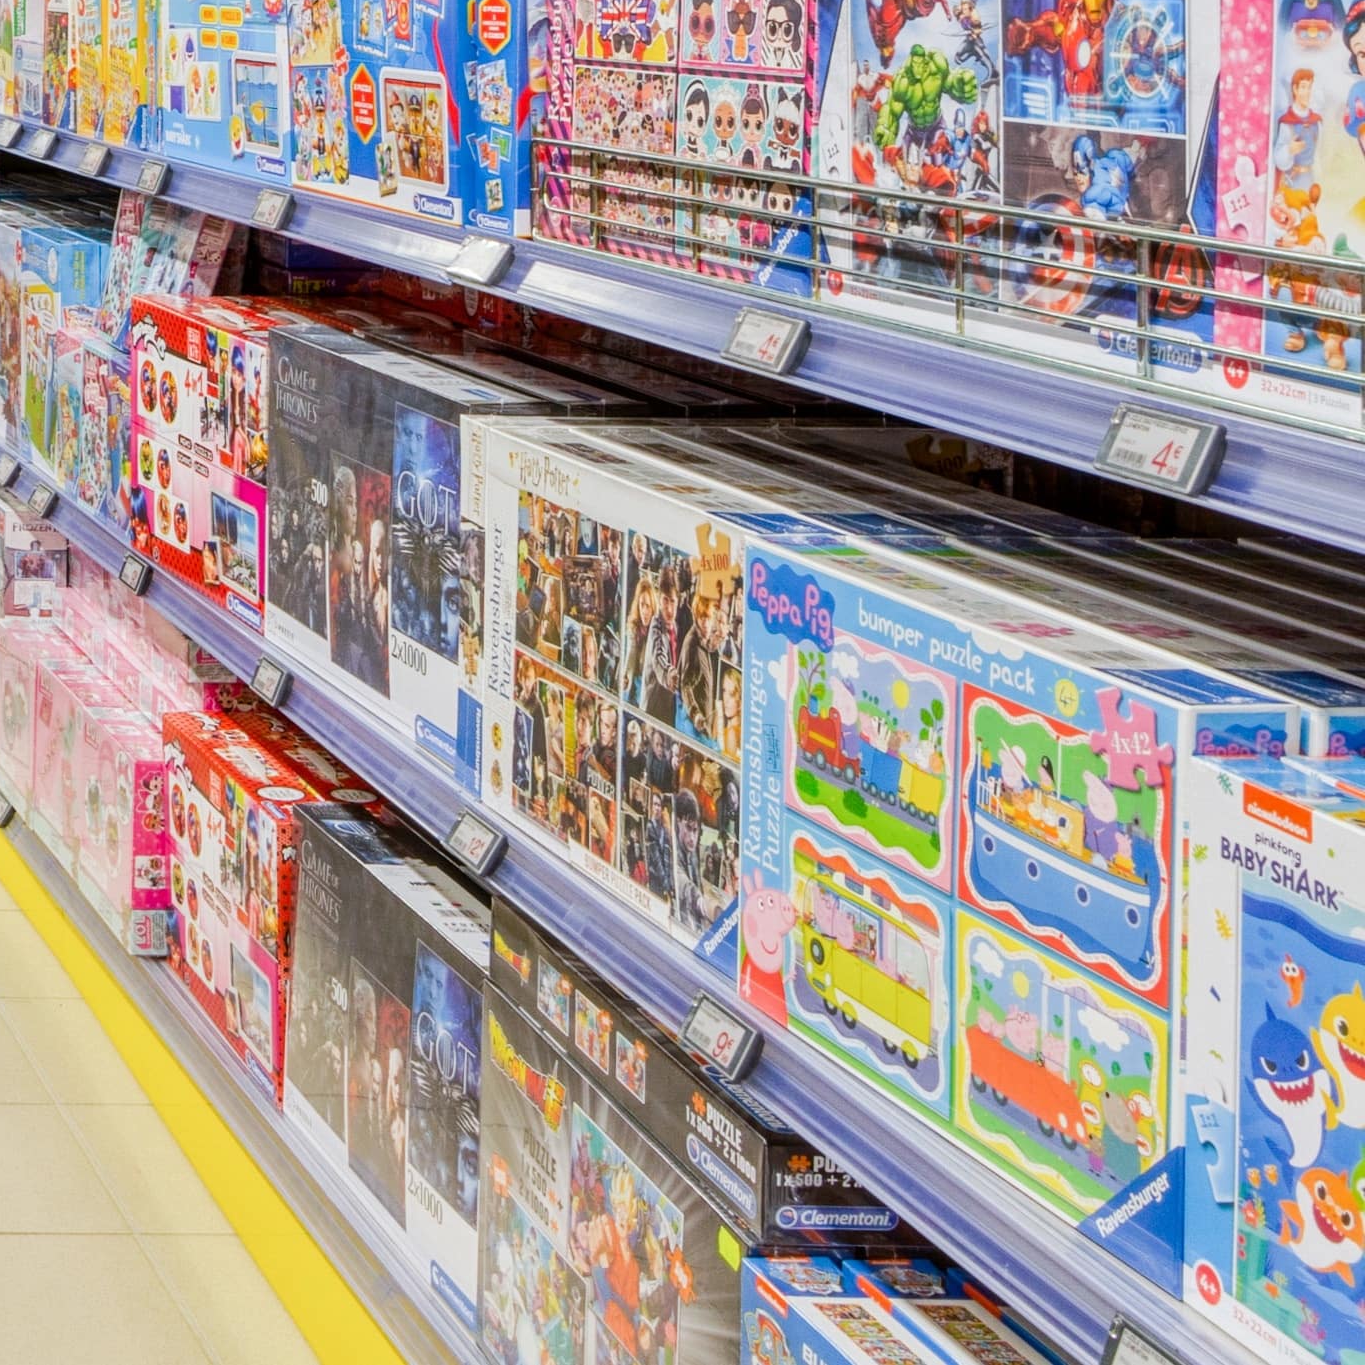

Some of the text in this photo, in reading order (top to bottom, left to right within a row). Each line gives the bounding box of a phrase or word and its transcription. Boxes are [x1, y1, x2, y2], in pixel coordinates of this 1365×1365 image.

[559, 38, 573, 125] Puzzle
[1228, 192, 1251, 216] 1:1
[278, 356, 308, 388] GAME
[1115, 331, 1197, 371] Cleentoni.
[1226, 361, 1248, 380] 4+
[274, 381, 319, 423] THRONES
[310, 478, 328, 508] 500
[517, 452, 571, 494] Harry Potter
[395, 470, 458, 535] GOT
[698, 550, 730, 572] 4x100
[487, 523, 503, 693] Ravensburger
[752, 561, 832, 642] Peppa Pig
[391, 635, 428, 676] 2x1000
[498, 618, 511, 701] Puzzle
[858, 603, 1036, 695] bumper puzzle pack
[744, 651, 768, 863] Ravensburger
[1111, 732, 1152, 757] 4x42
[762, 777, 781, 875] Puzzle
[1247, 802, 1308, 838] nickelodeon
[301, 839, 331, 884] GAME
[1255, 833, 1301, 868] pinkfong
[1221, 836, 1339, 911] BABY SHARK
[704, 910, 739, 956] Ravensbur
[330, 977, 348, 1011] 500
[417, 1011, 477, 1102] GOT
[706, 1101, 742, 1152] PUZZLE
[1200, 1114, 1219, 1128] 1:1
[801, 1207, 892, 1226] Clementoni.
[1096, 1172, 1170, 1237] Ravensburger
[1199, 1275, 1217, 1294] 4+
